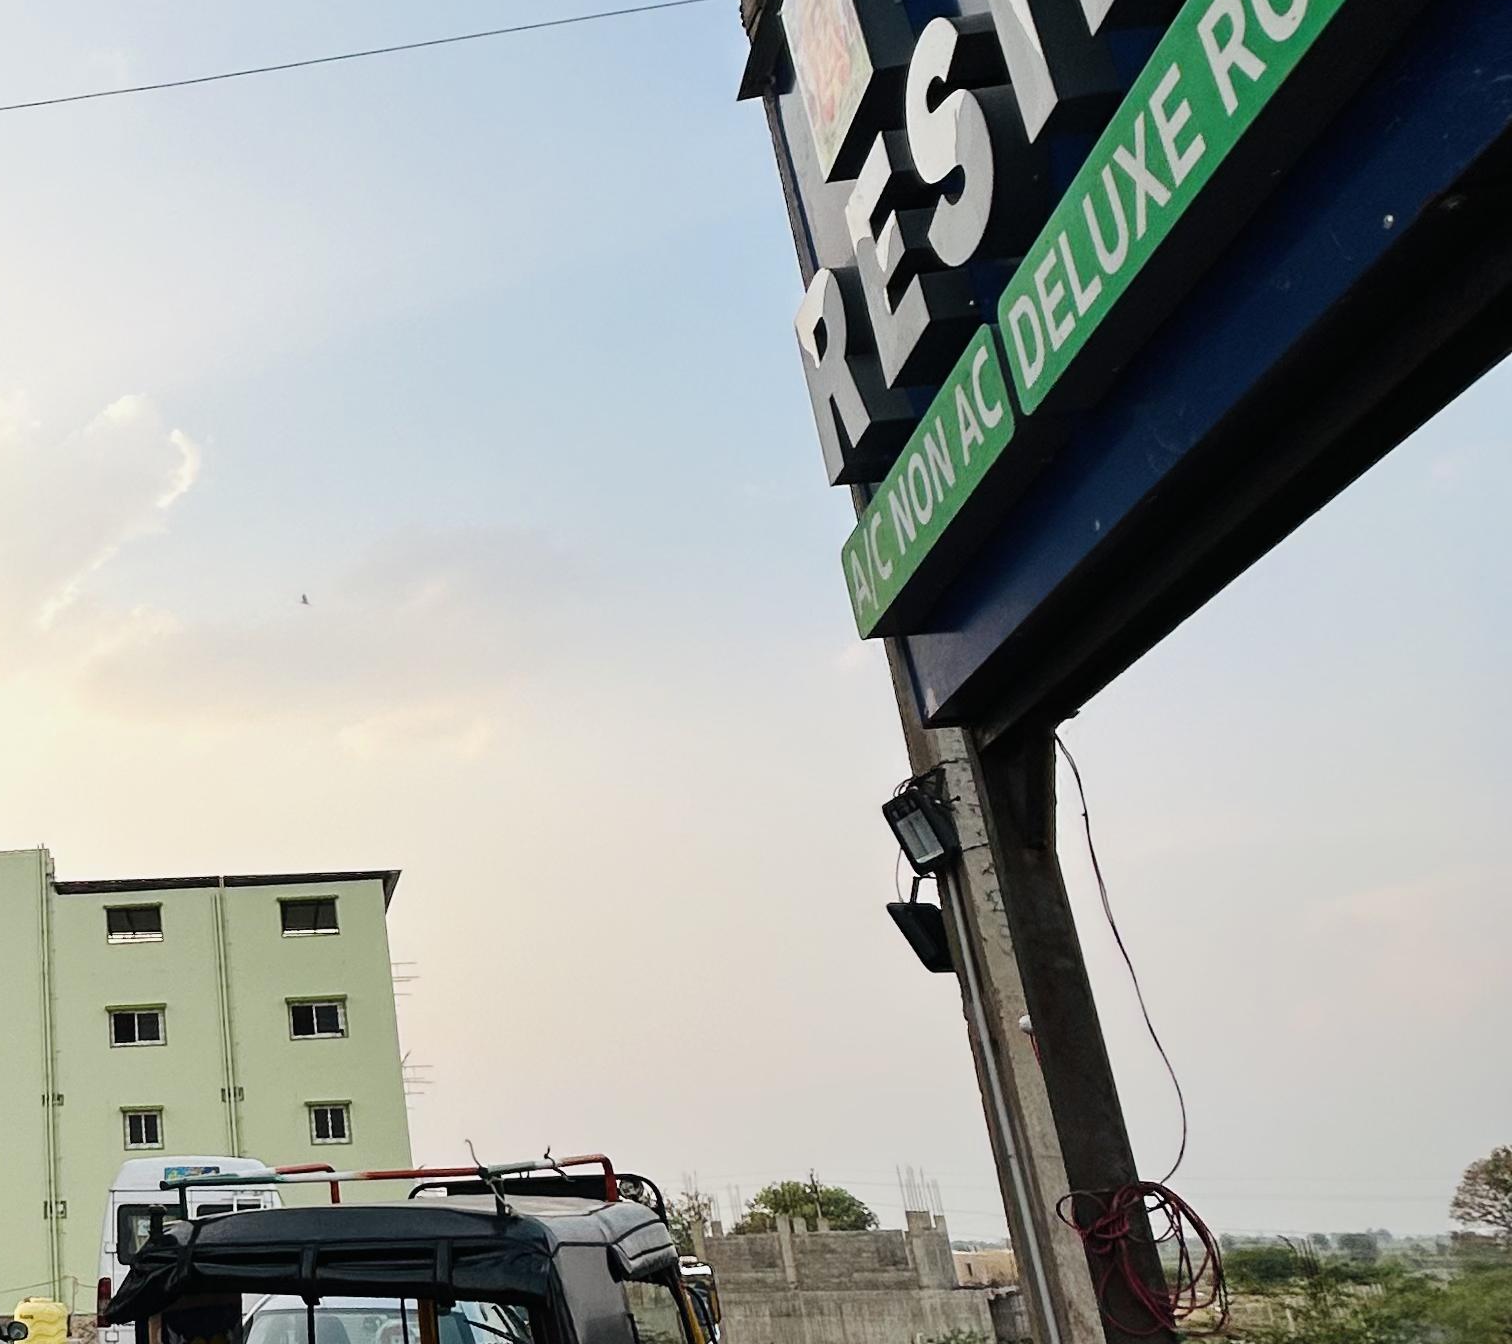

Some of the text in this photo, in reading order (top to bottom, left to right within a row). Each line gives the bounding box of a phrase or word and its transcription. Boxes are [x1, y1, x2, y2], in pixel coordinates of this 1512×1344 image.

[1007, 60, 1207, 392] DELUXE
[850, 345, 1004, 622] A/C NON AC
